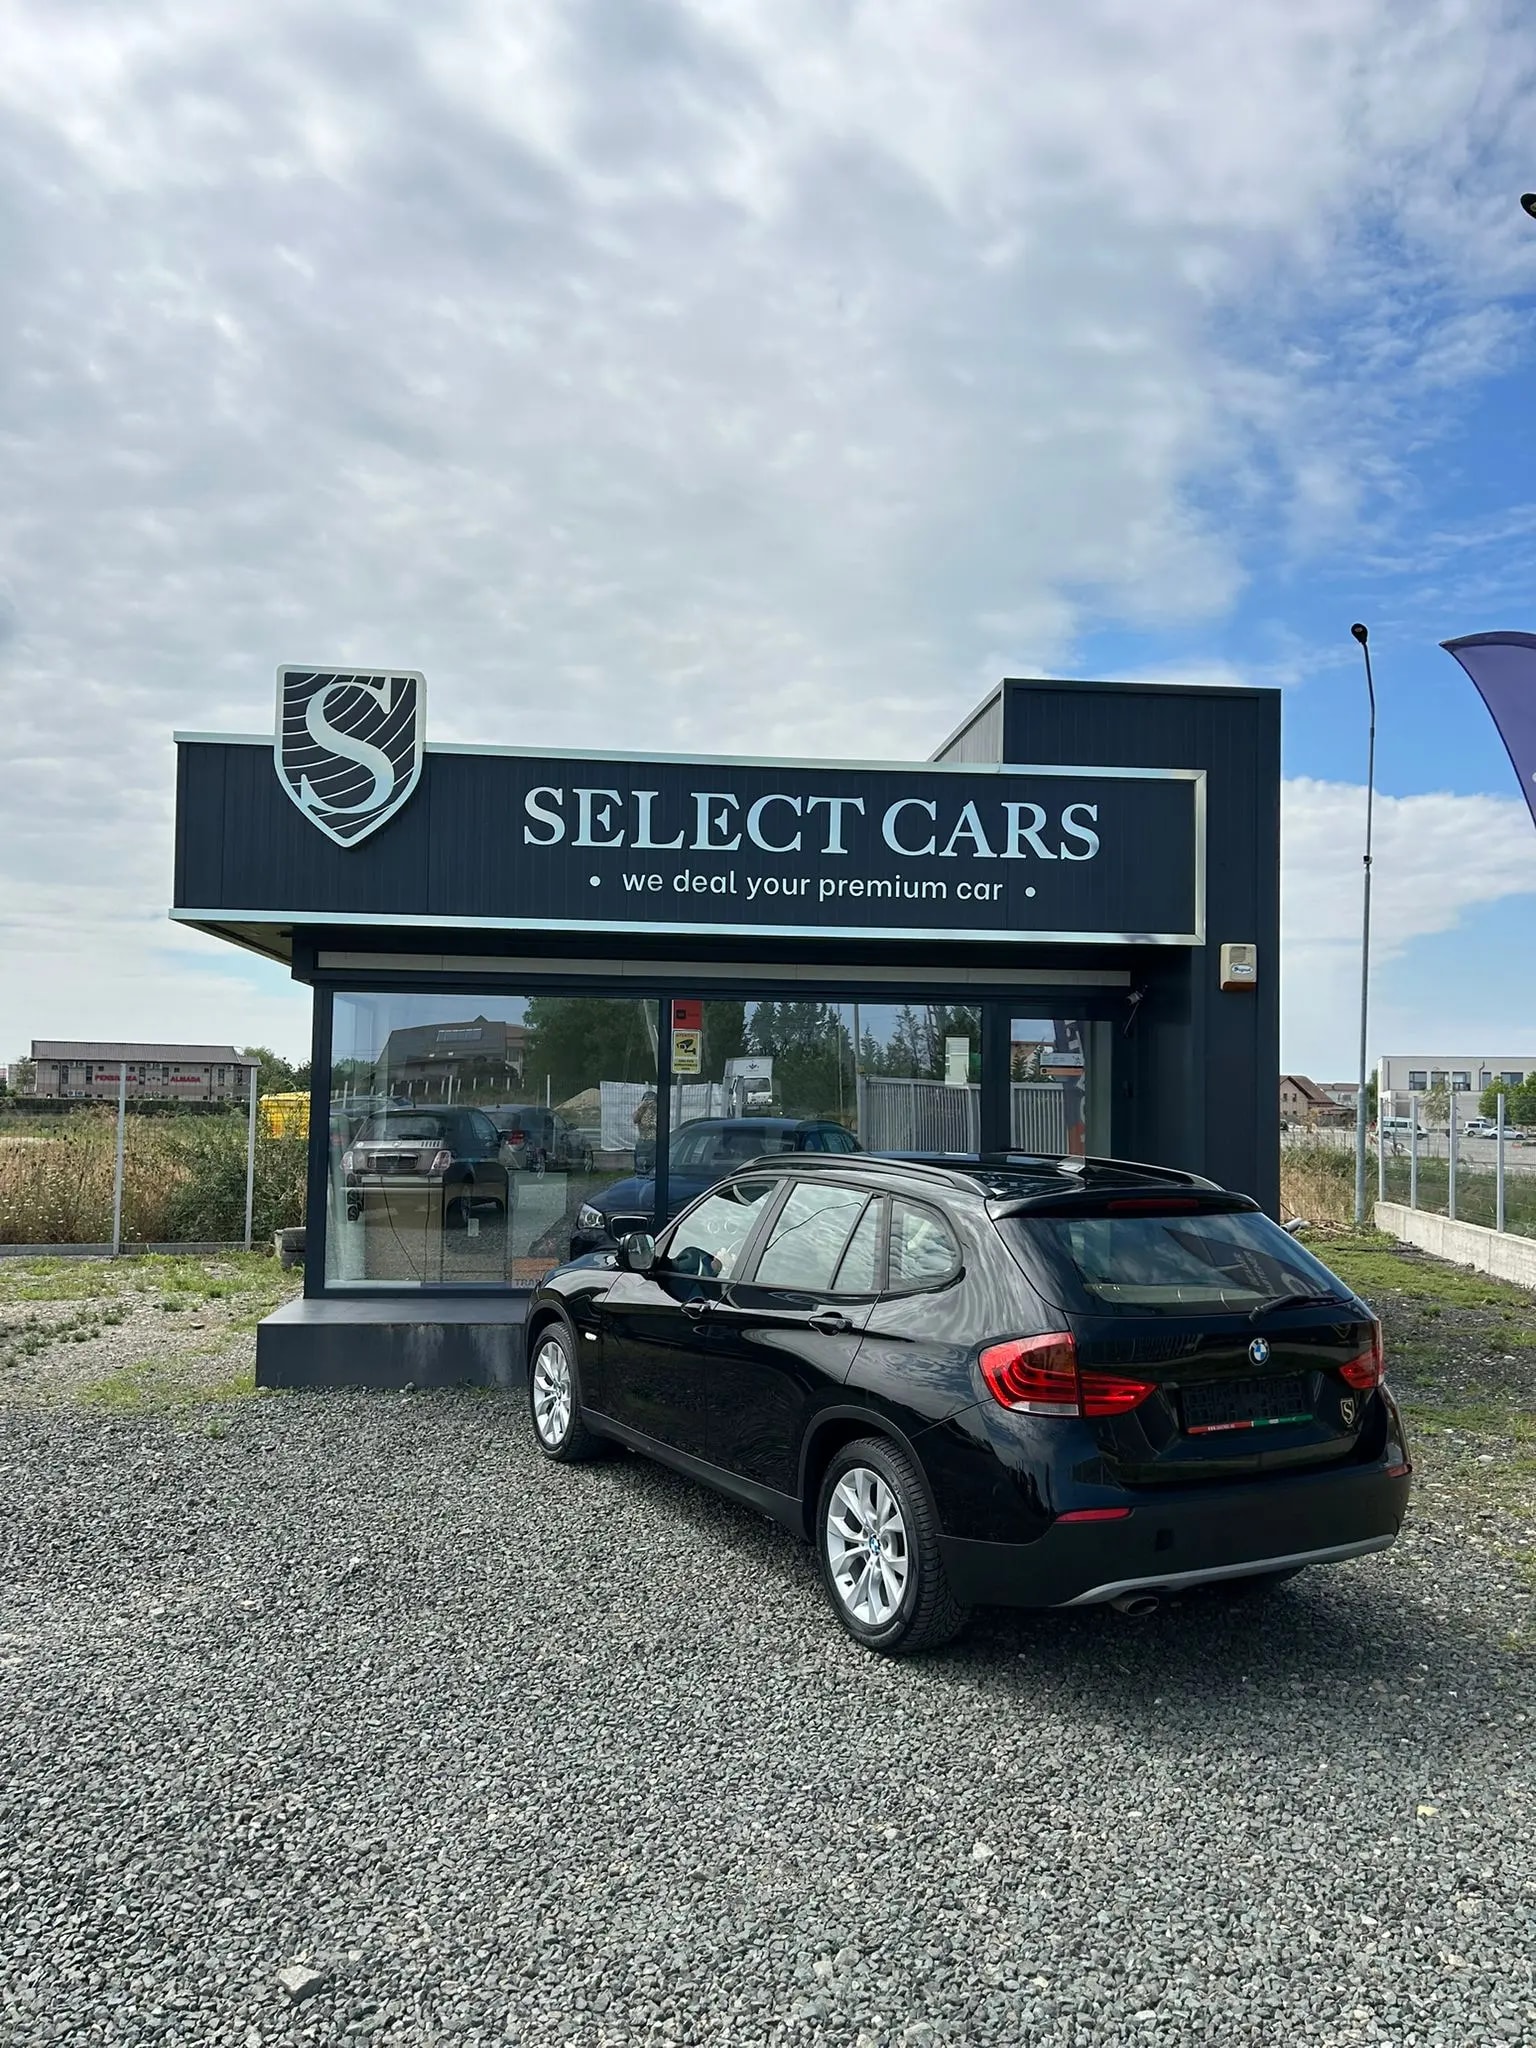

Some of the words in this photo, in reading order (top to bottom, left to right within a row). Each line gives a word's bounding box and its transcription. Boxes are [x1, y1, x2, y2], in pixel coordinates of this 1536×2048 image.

[301, 676, 394, 814] S
[523, 786, 867, 855] SELECT
[881, 798, 1101, 861] CARS
[622, 873, 664, 892] we
[673, 869, 738, 894] deal
[746, 876, 812, 902] your
[819, 874, 948, 902] premium
[956, 882, 1005, 901] car
